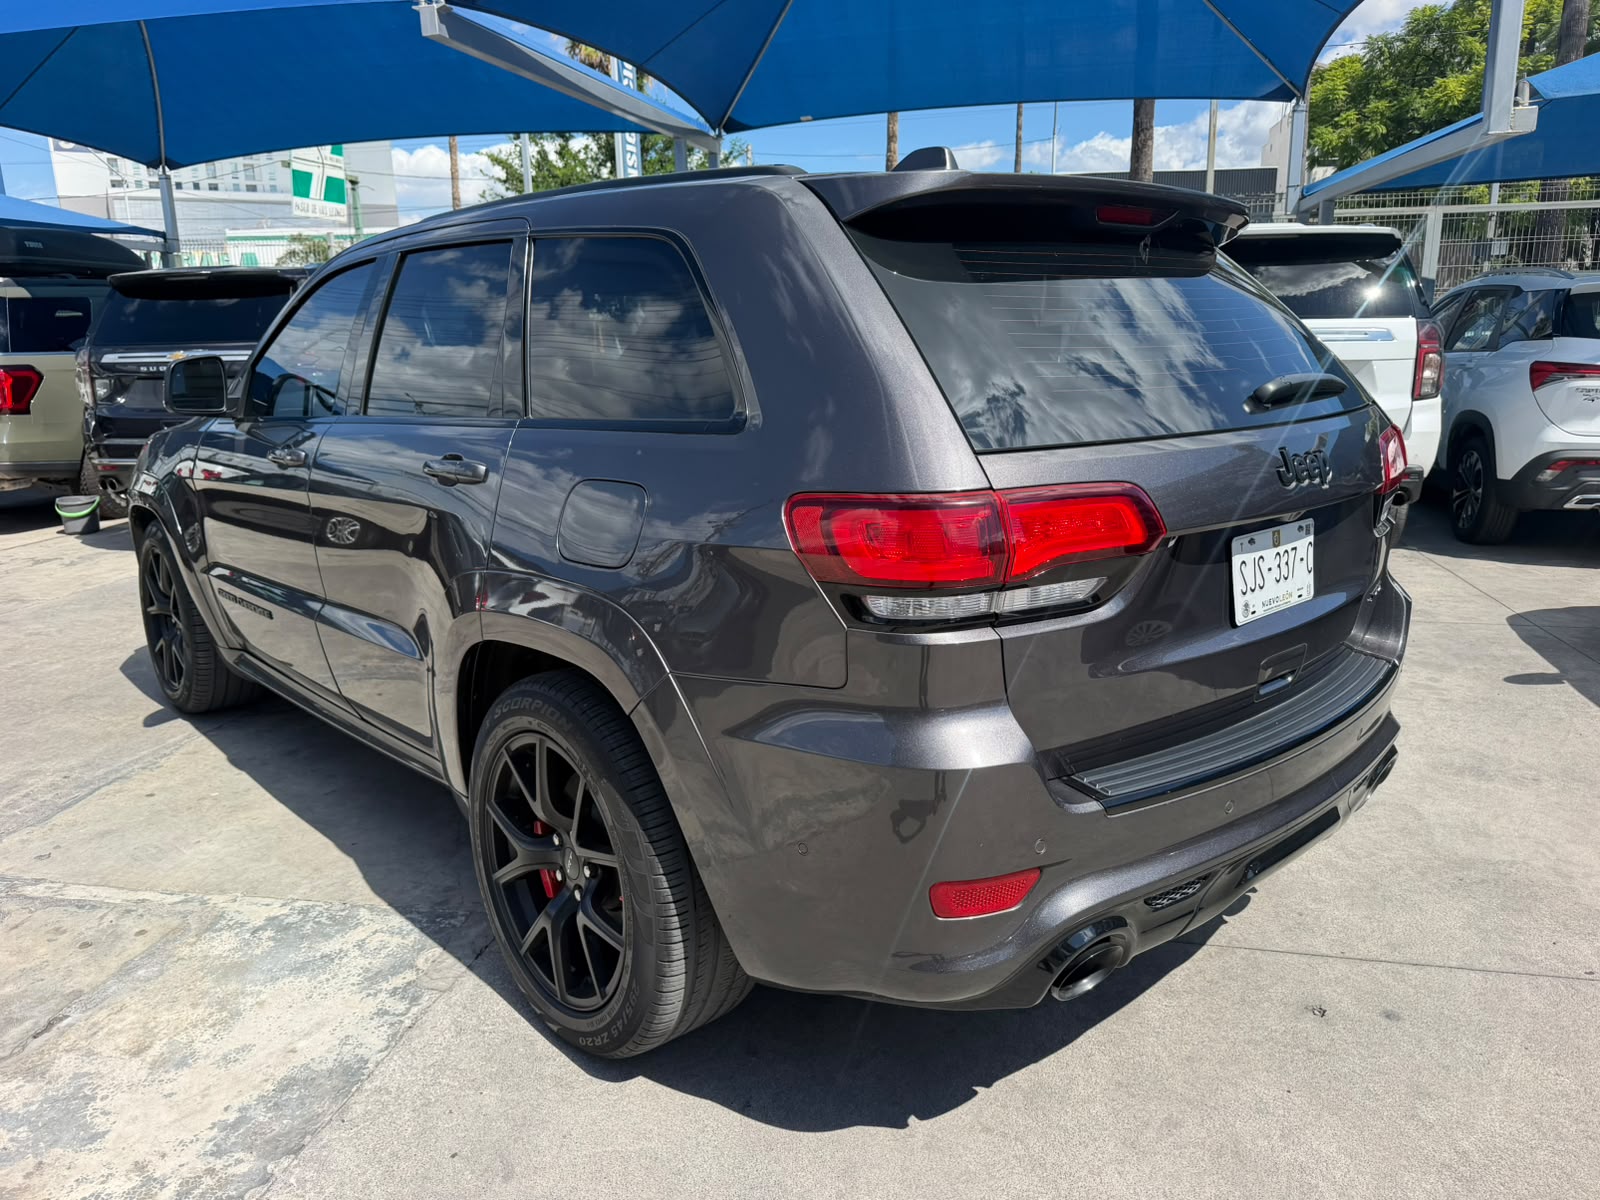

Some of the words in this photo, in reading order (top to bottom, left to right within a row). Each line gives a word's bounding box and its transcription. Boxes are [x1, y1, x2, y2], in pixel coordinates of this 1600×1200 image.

[1276, 447, 1333, 490] Jeep
[1239, 541, 1313, 596] SJS-337-C
[493, 696, 574, 732] SCORPION
[578, 1031, 610, 1047] ZR20
